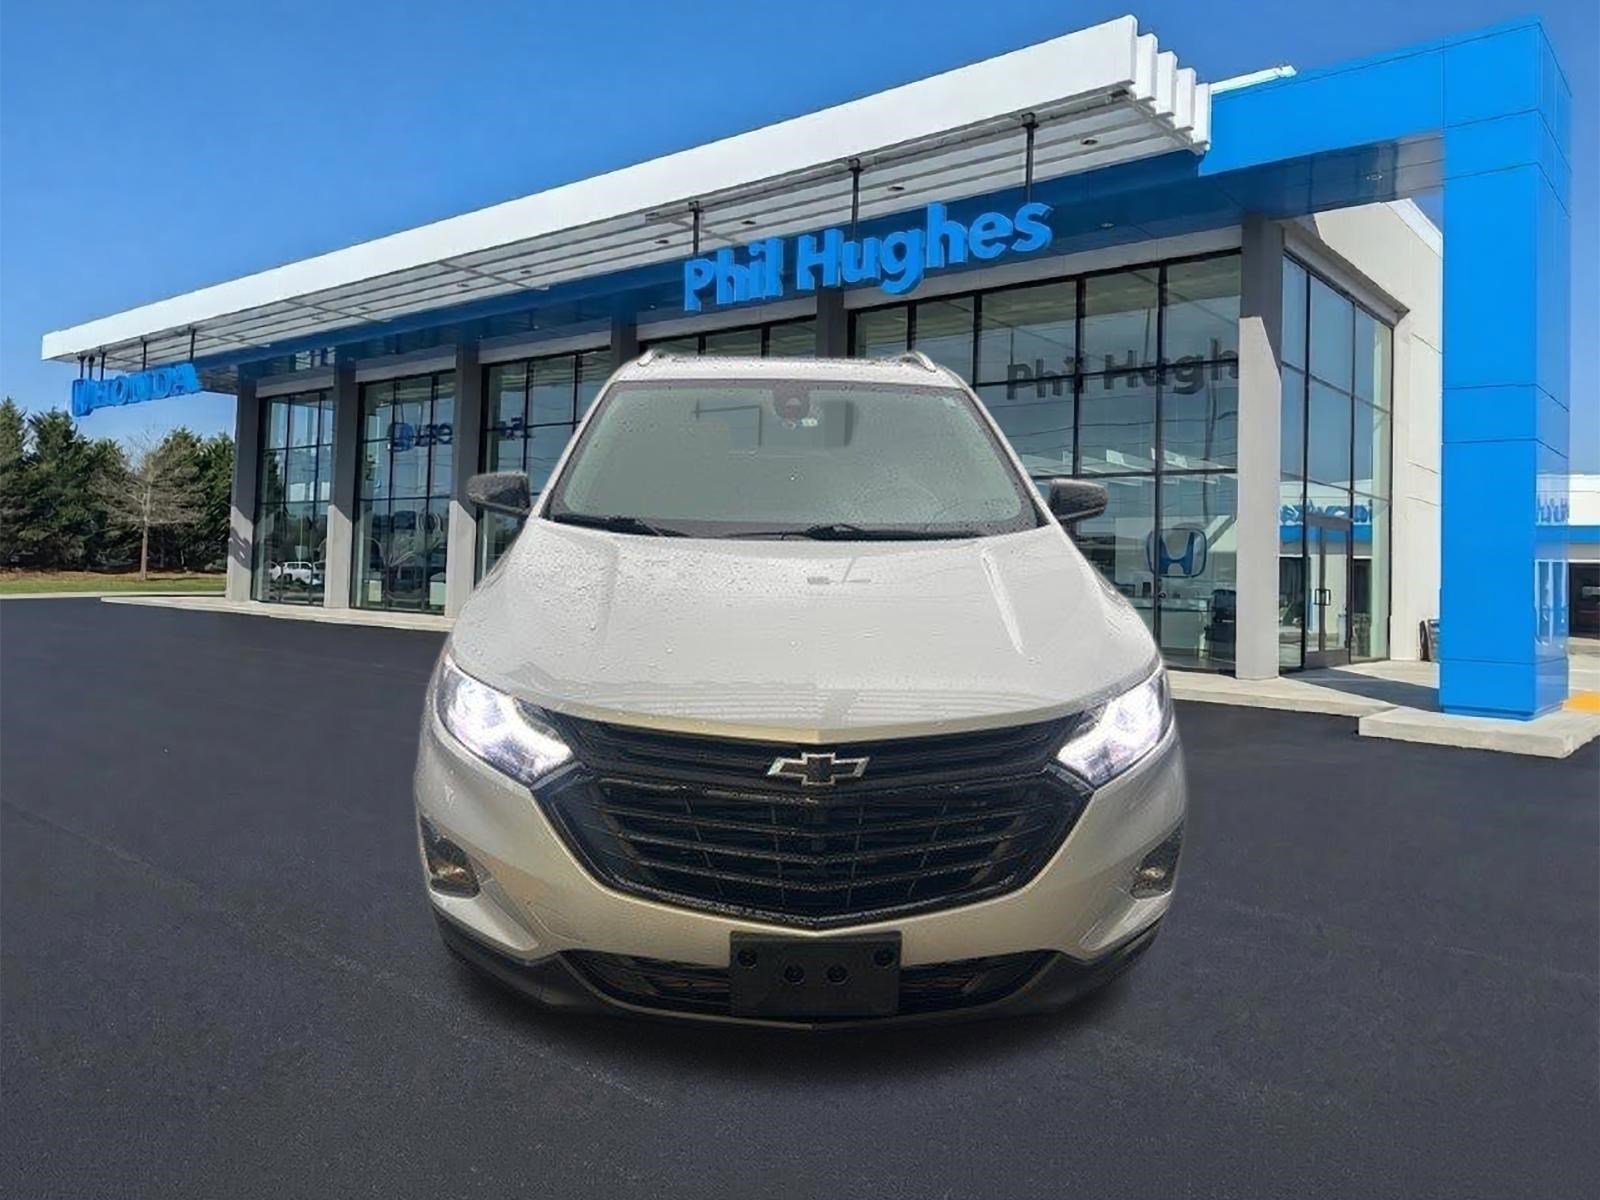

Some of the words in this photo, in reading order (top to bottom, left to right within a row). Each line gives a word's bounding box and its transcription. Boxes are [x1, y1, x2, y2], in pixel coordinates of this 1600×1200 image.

[684, 235, 783, 311] Phil
[796, 201, 1053, 295] Hughes
[91, 362, 199, 409] HONDA
